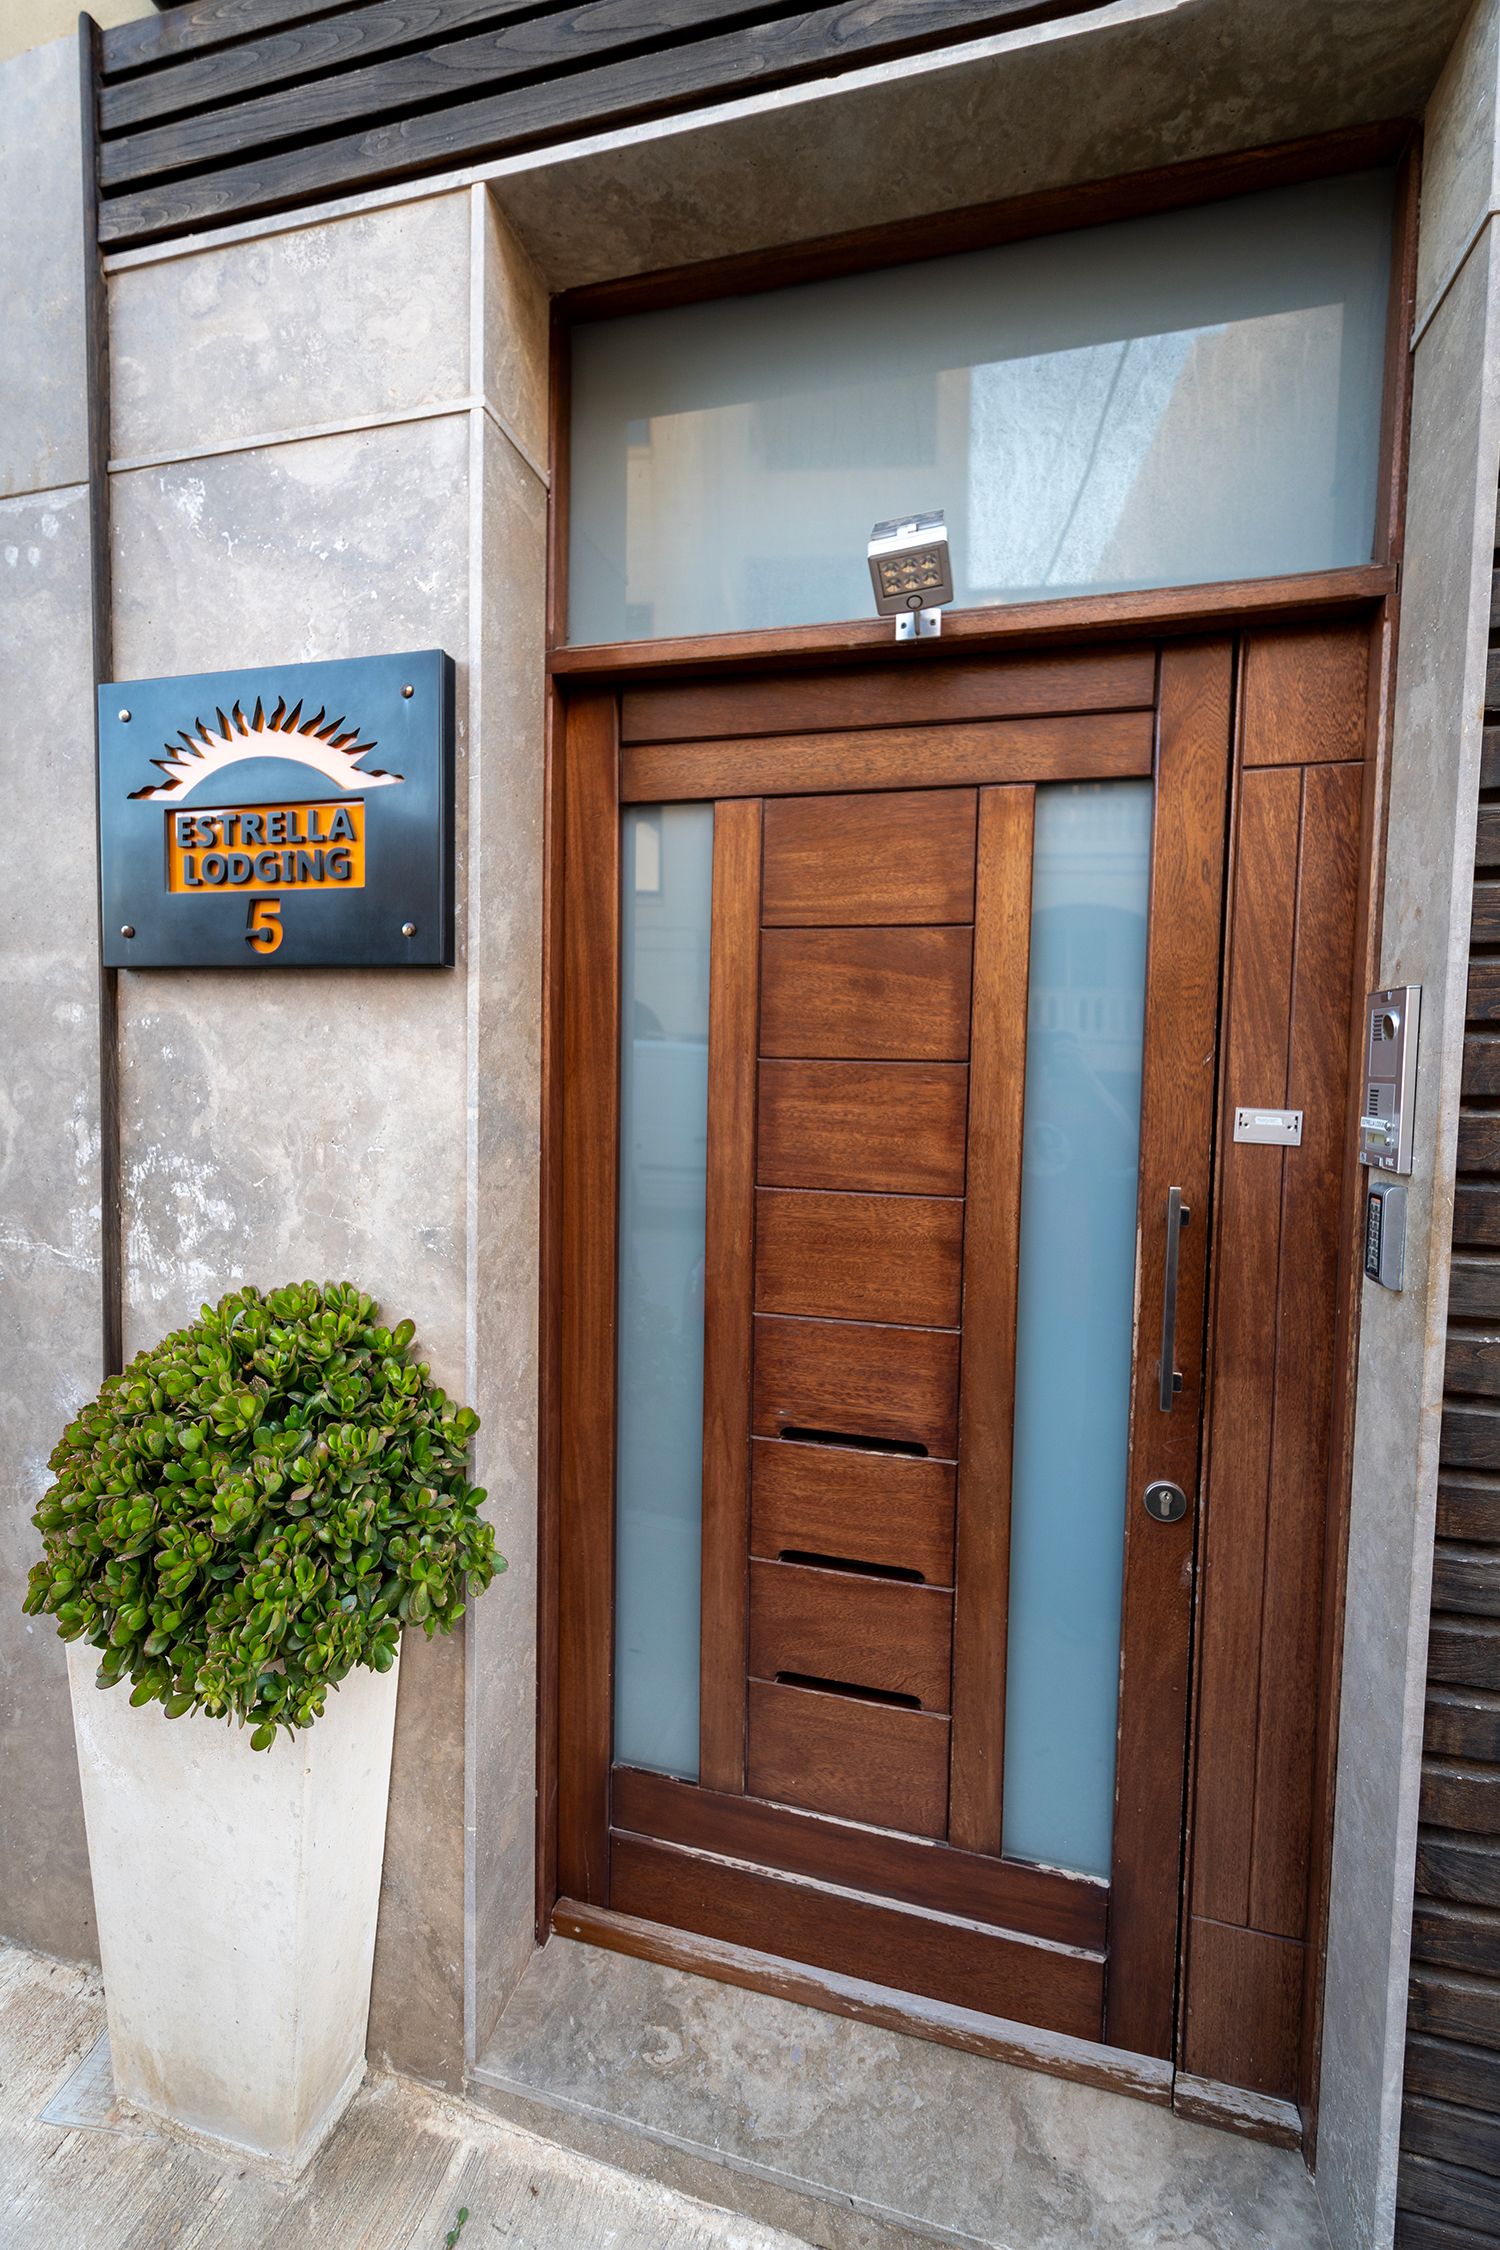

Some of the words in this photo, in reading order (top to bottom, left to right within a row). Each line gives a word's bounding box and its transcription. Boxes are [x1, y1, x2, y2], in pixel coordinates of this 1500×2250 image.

[176, 808, 355, 848] ESTRELLA
[183, 847, 353, 886] LODGING
[245, 898, 284, 954] 5
